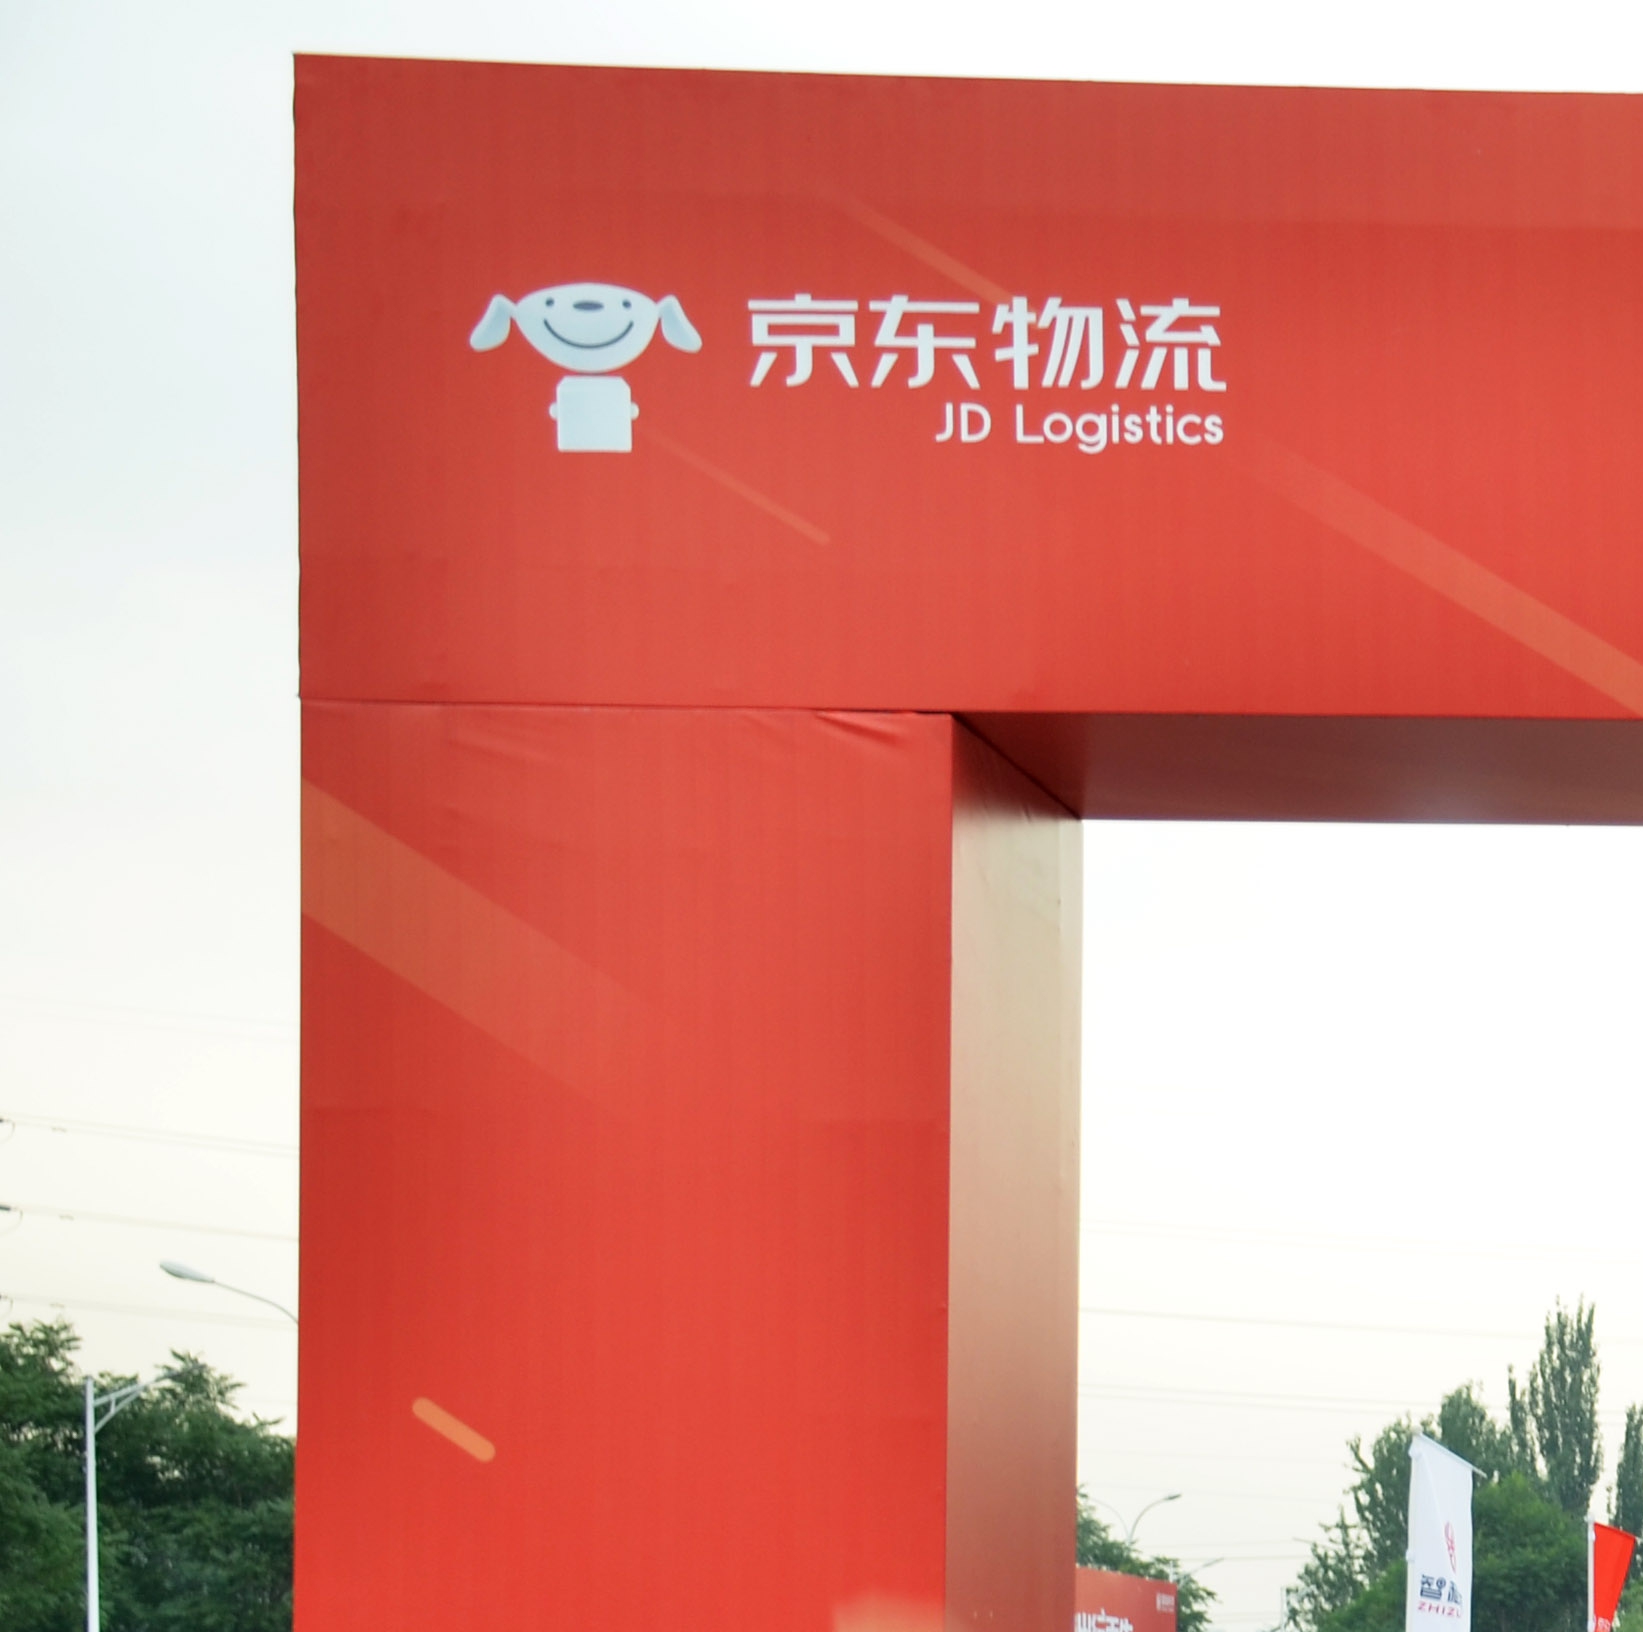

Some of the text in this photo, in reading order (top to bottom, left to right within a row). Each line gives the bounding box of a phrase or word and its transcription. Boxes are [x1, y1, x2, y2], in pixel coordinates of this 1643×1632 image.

[747, 293, 1227, 391] 京东物流
[935, 402, 1225, 454] JD Logistics
